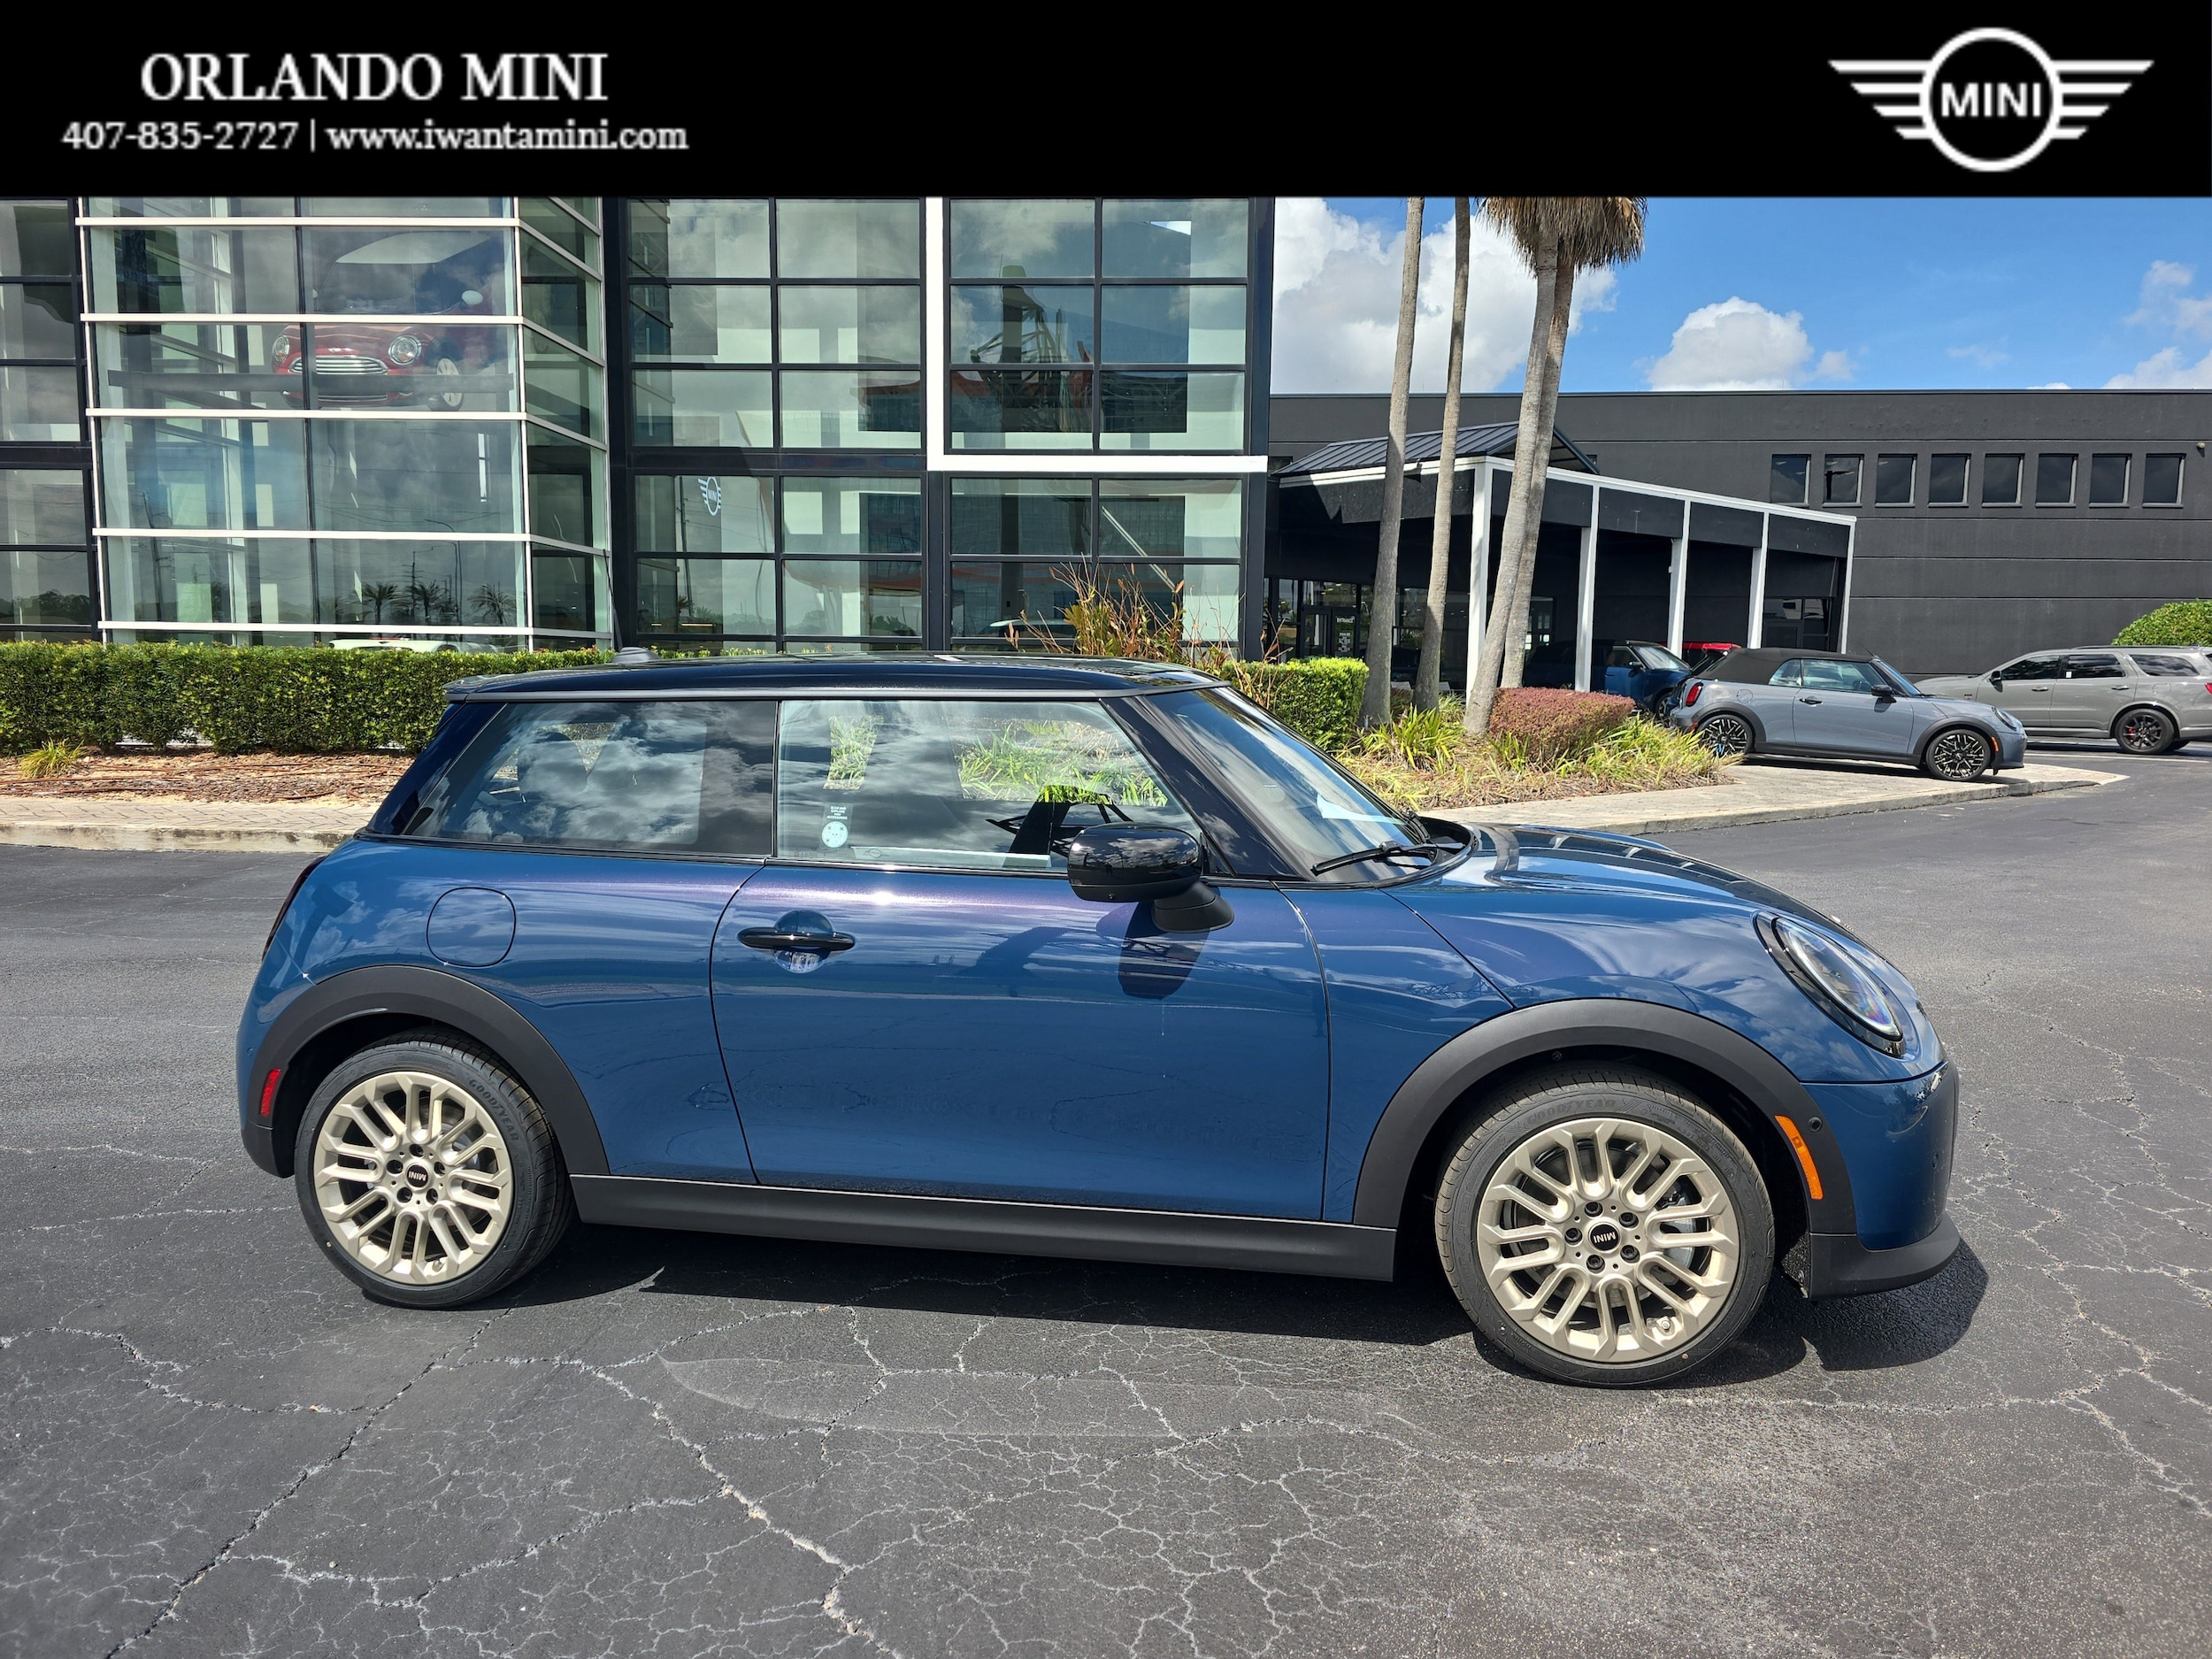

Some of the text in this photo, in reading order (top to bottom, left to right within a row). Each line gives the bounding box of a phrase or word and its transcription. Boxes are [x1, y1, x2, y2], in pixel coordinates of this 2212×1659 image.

[469, 1079, 519, 1141] GOODYEAR
[1527, 1098, 1617, 1125] GOODYEAR
[408, 1171, 426, 1182] MINI
[1593, 1231, 1617, 1244] MINI
